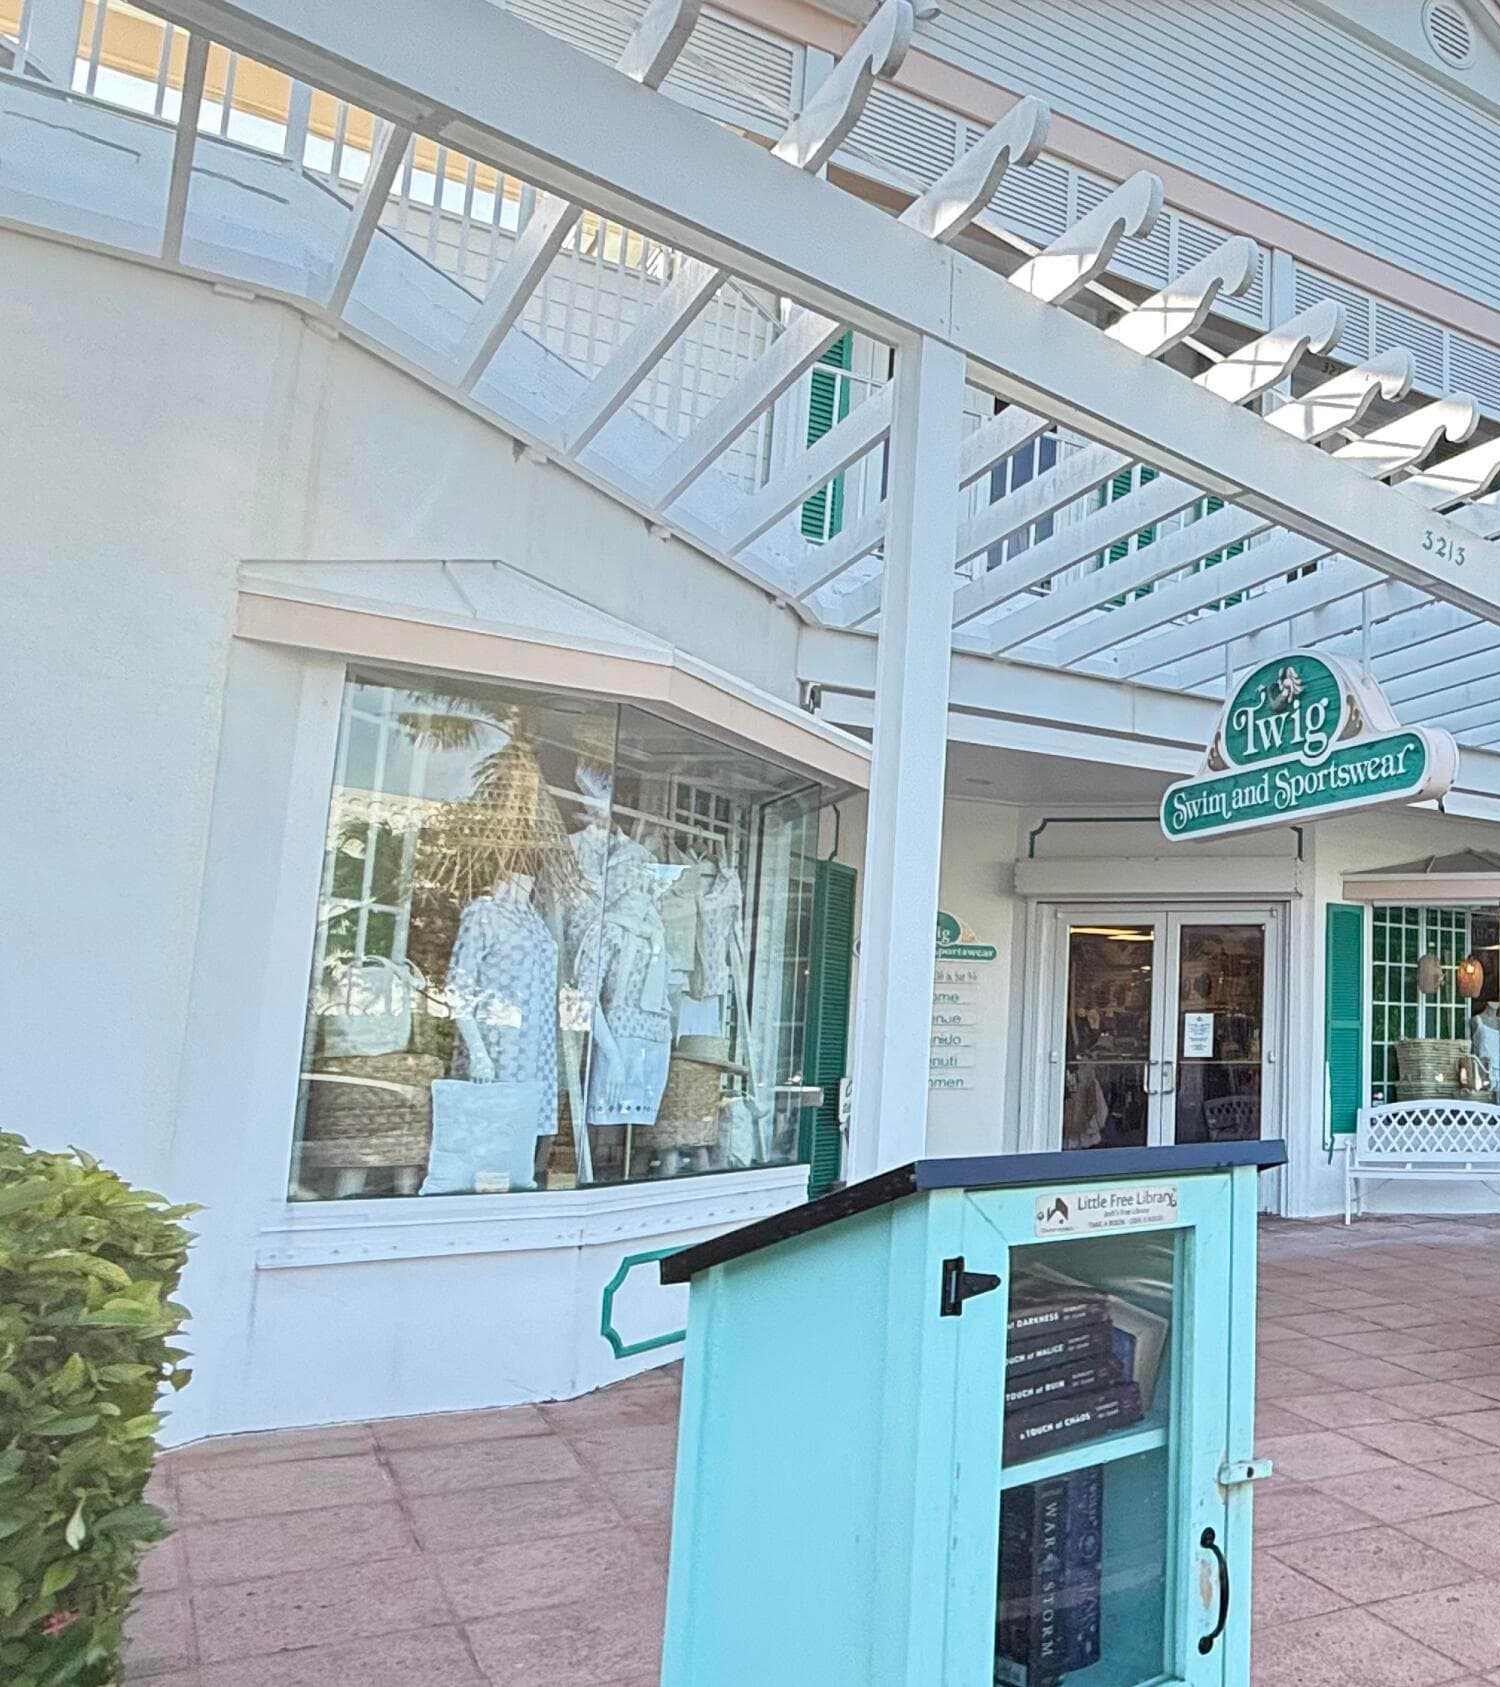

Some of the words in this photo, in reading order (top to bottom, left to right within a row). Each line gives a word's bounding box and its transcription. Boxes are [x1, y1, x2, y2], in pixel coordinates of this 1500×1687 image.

[1422, 530, 1465, 566] 3213
[1232, 688, 1329, 756] Twig
[1172, 791, 1231, 830] Swim
[1232, 772, 1269, 811] and
[1274, 743, 1415, 810] Sportswear
[1078, 1194, 1107, 1211] Little
[1110, 1194, 1135, 1207] Free
[1137, 1190, 1175, 1208] Library
[1016, 1311, 1060, 1329] DARKNESS
[1036, 1343, 1065, 1358] MALICE
[1006, 1387, 1034, 1401] TOUCH
[1026, 1422, 1054, 1438] TOUCH
[1044, 1502, 1058, 1549] WAR
[1041, 1581, 1056, 1656] STORM
